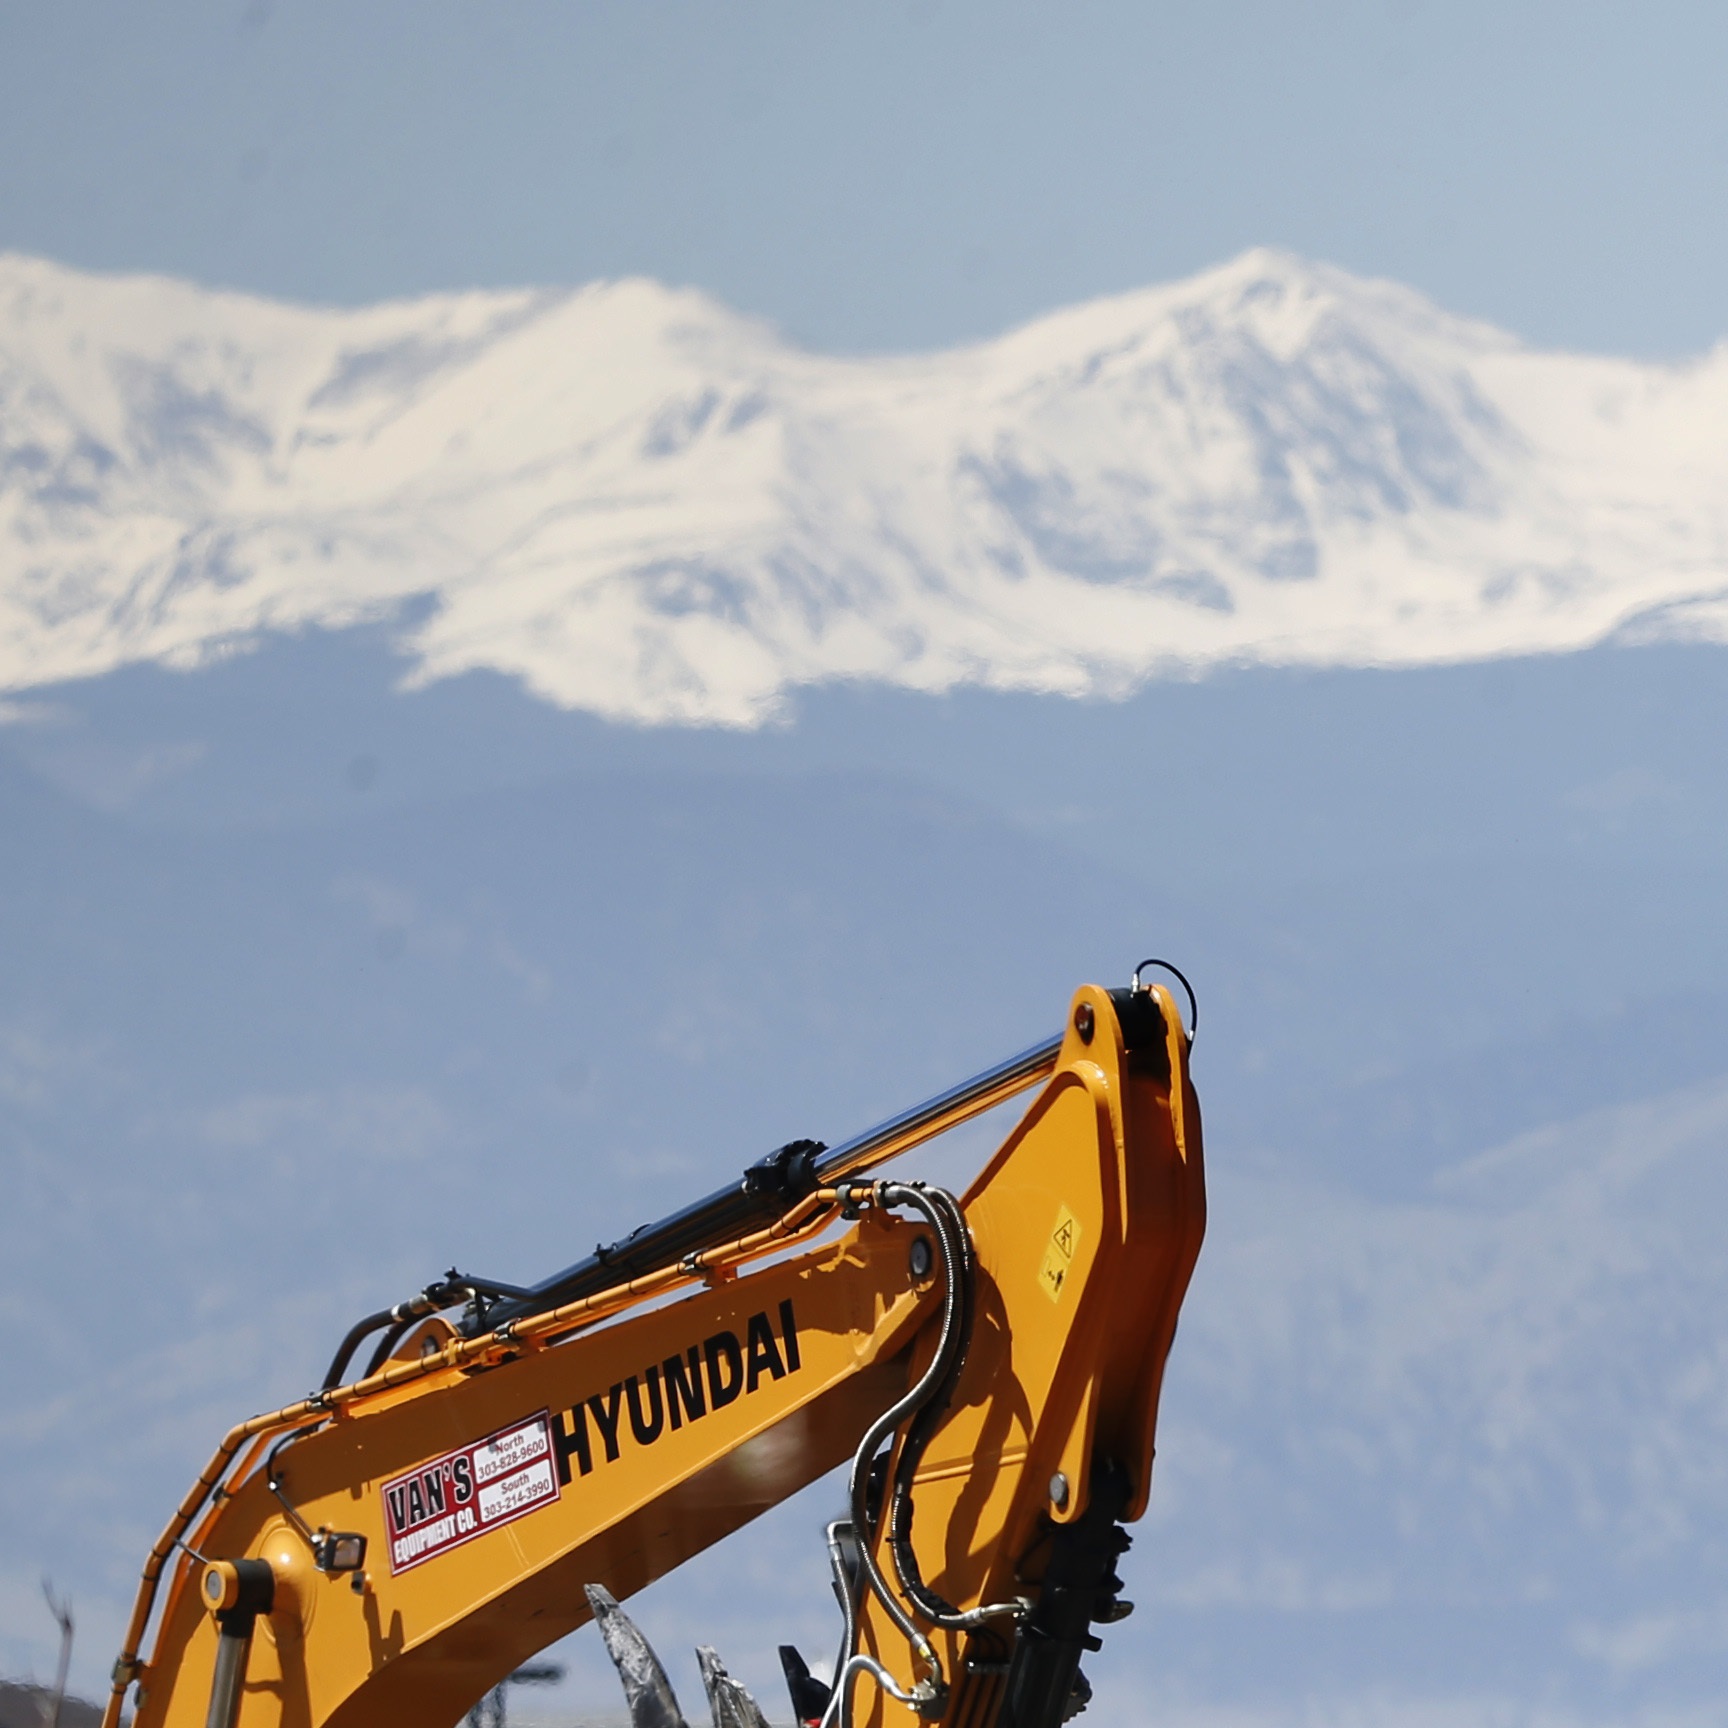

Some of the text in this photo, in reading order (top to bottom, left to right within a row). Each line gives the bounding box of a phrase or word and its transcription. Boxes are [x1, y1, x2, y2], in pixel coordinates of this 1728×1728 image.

[551, 1299, 801, 1486] HYUNDAI
[478, 1439, 544, 1479] 303-828-9600
[495, 1434, 524, 1453] North
[387, 1455, 474, 1534] VAN'S
[484, 1479, 549, 1519] 303-214-3990
[501, 1473, 530, 1494] South
[393, 1507, 478, 1563] EQUIPMENT CO.
